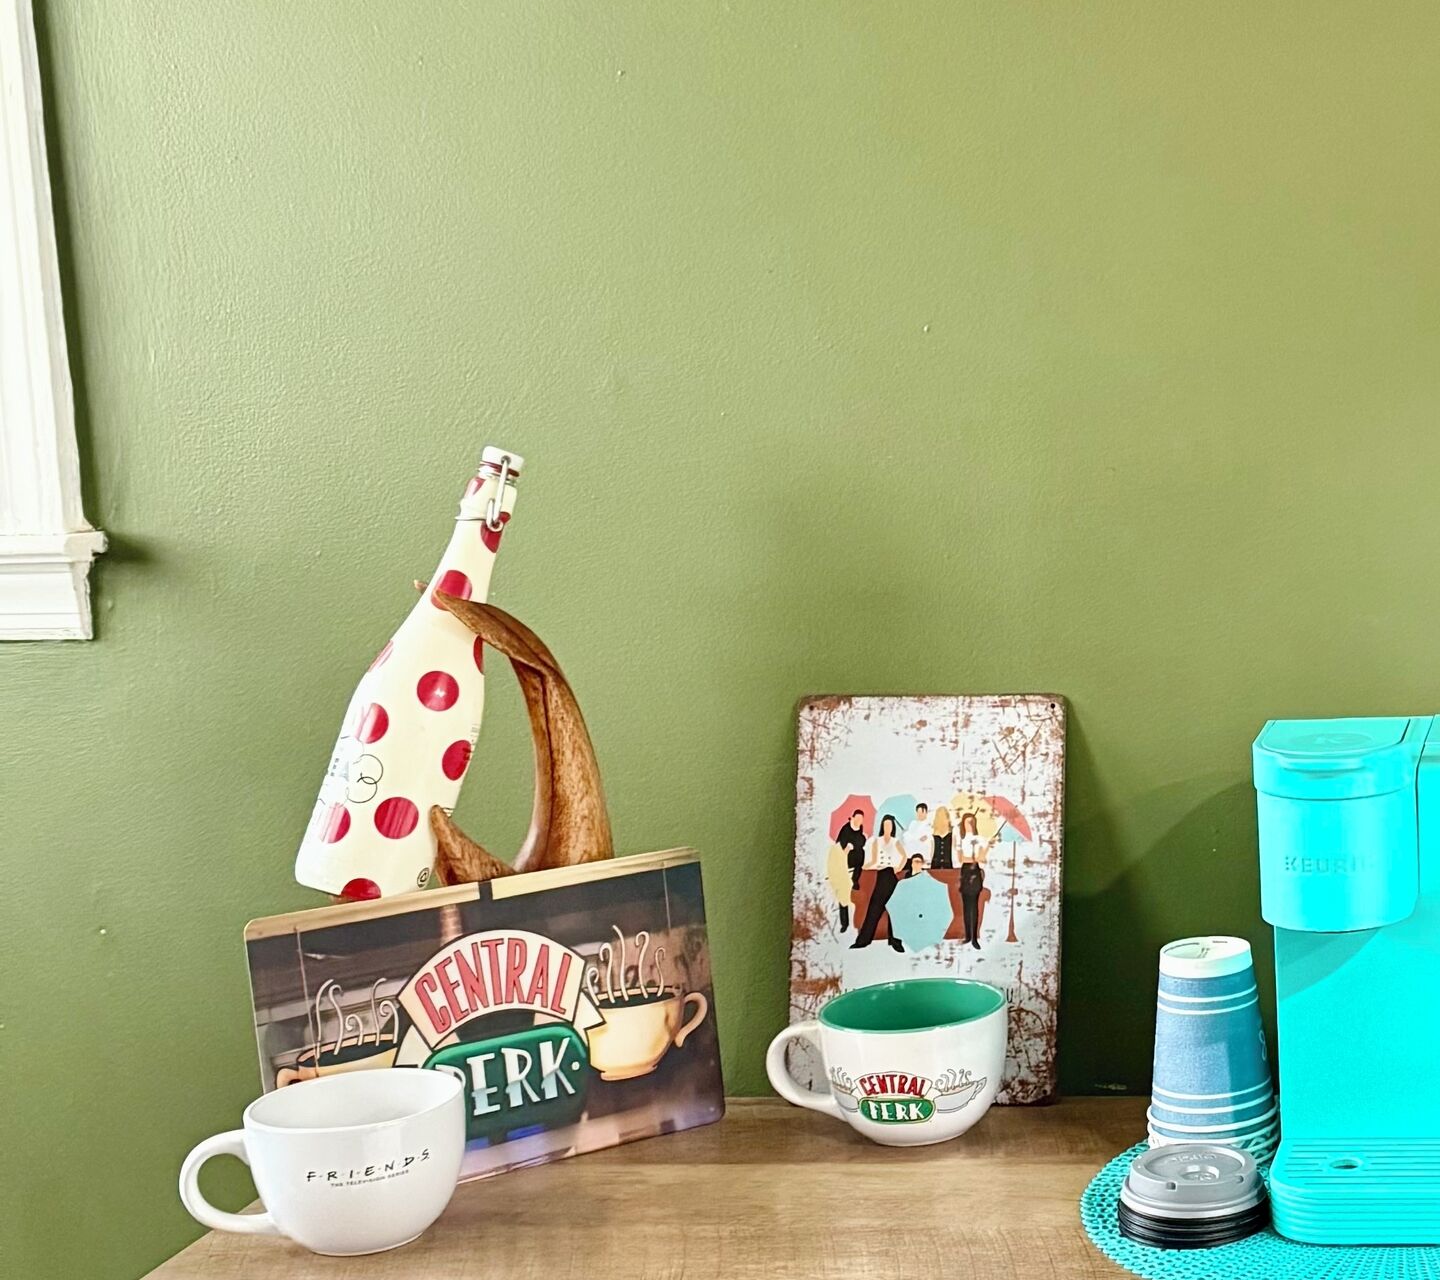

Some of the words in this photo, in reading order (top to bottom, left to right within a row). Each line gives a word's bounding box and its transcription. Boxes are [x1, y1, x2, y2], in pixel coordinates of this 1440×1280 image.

[1284, 855, 1377, 873] KEURI
[414, 938, 572, 1035] CENTRAL
[859, 1074, 928, 1098] CENTRAL
[868, 1100, 925, 1121] PERK
